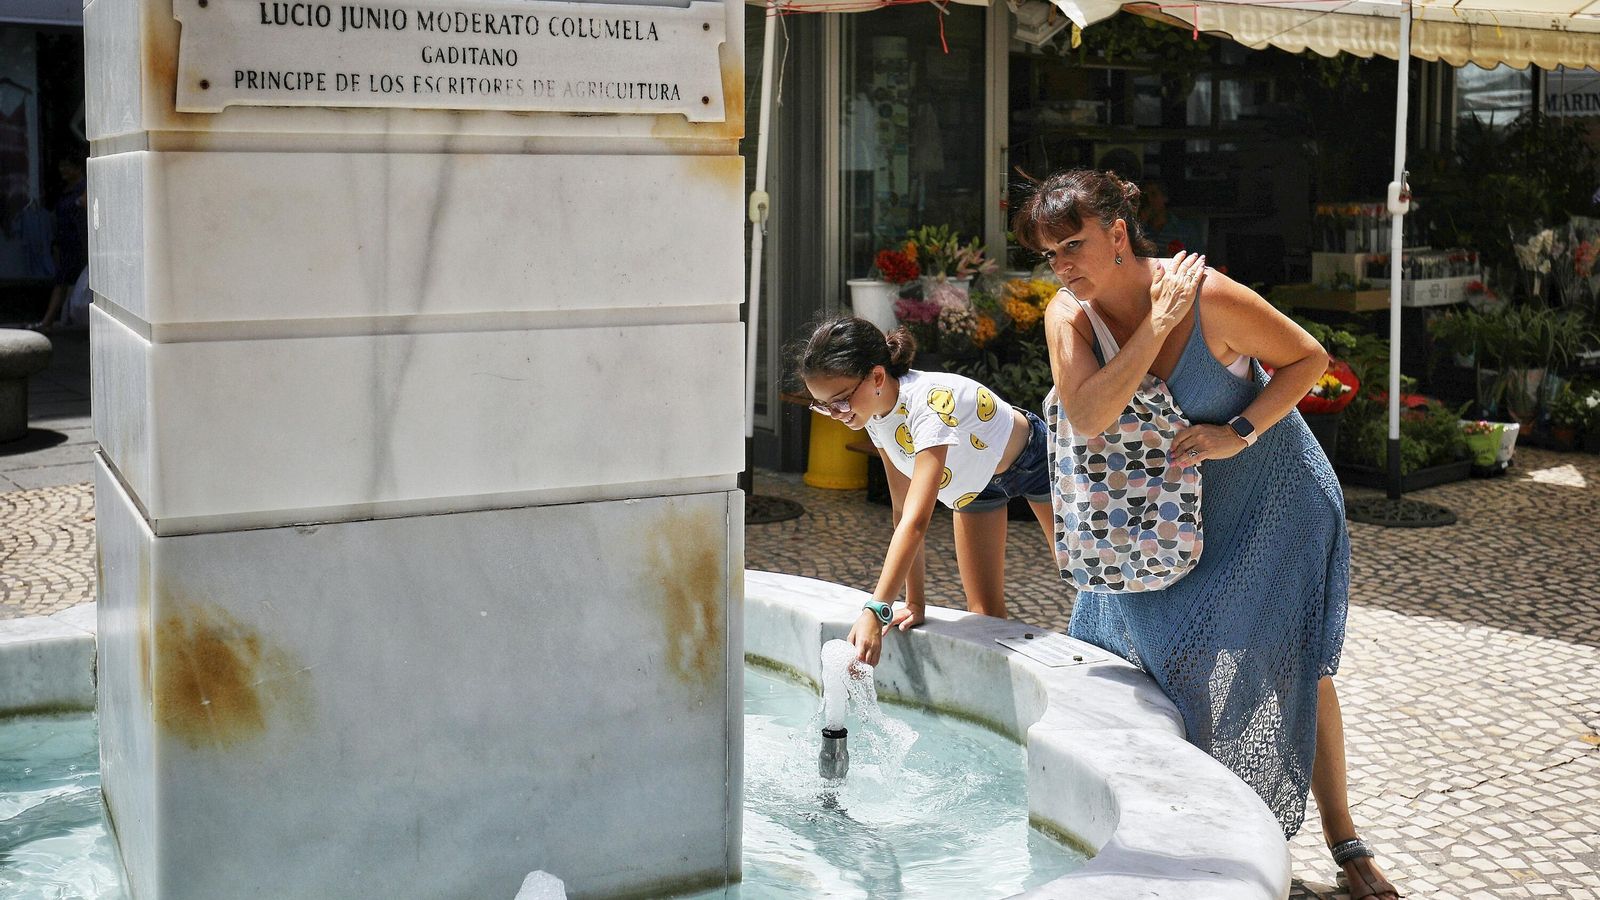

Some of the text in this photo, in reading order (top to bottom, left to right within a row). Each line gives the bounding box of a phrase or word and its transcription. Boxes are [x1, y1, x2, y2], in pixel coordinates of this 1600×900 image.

[260, 2, 659, 41] LUCIO JUNIO MODERATO COLUMELA
[421, 46, 518, 67] GADITANO
[234, 70, 681, 101] PRINCIPE DE LOS ESCRITORES DE AGRICULTURA
